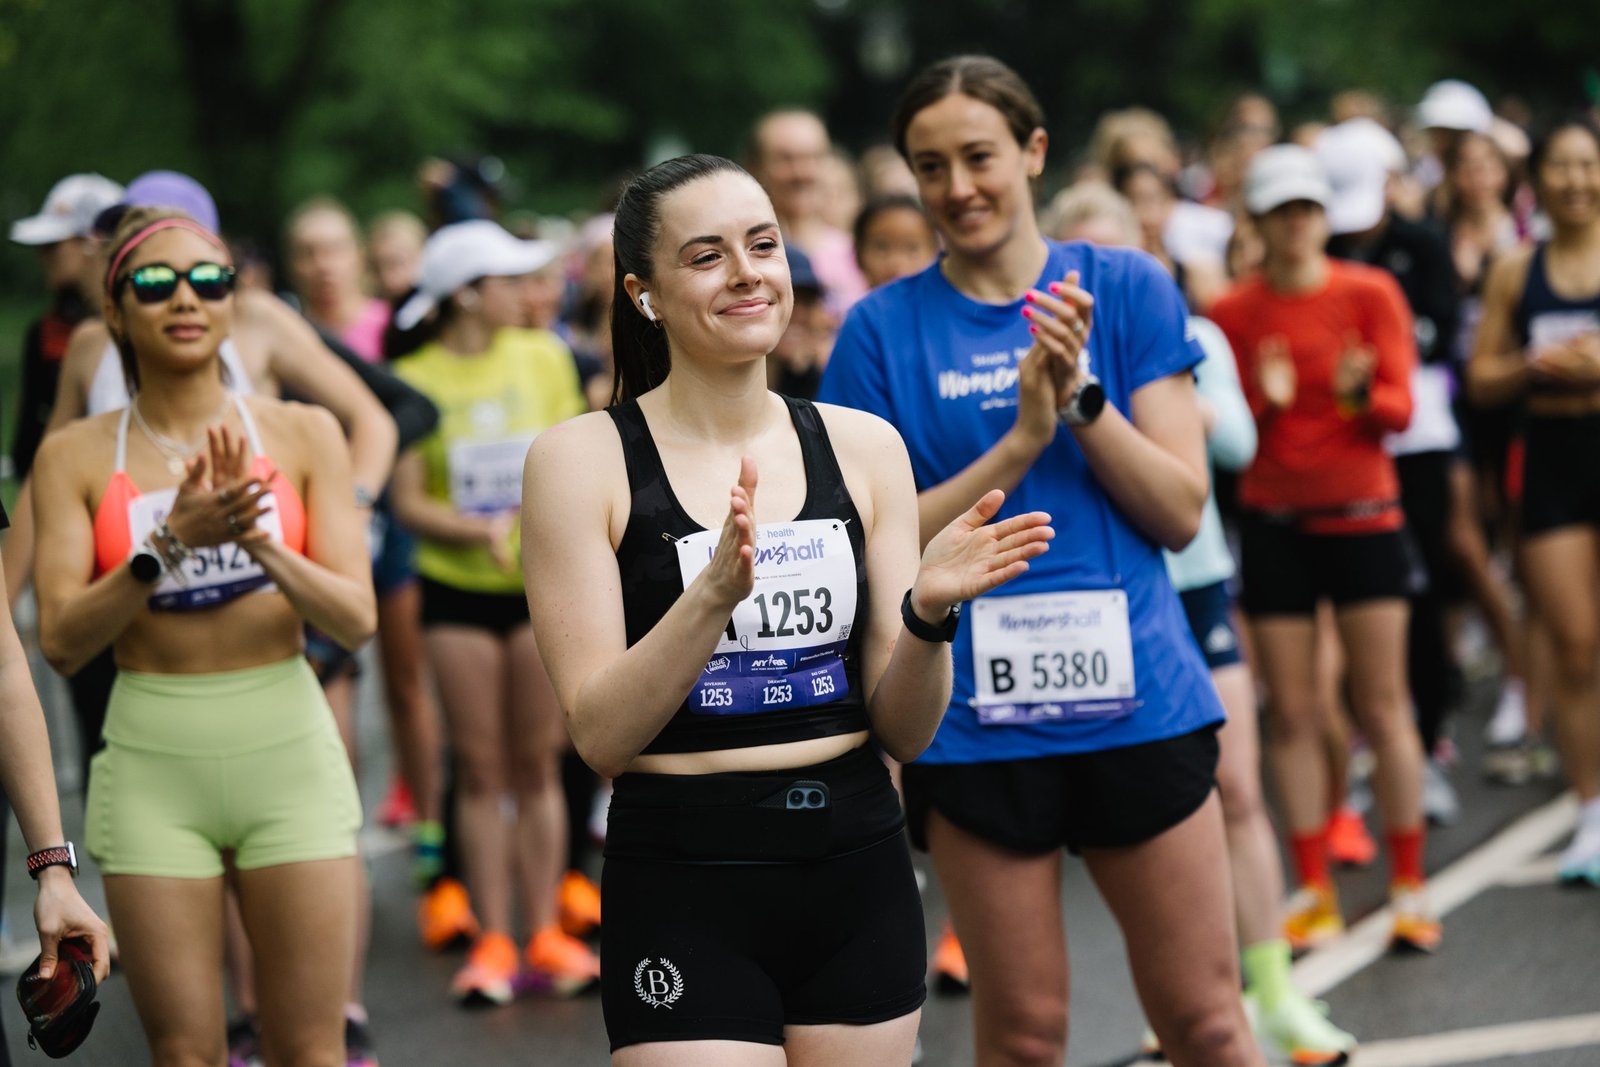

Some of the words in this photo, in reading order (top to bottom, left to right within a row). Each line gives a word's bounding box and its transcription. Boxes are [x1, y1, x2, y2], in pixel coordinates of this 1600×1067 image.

[766, 528, 795, 539] health
[753, 587, 833, 638] 1253
[708, 657, 725, 668] TRUE
[989, 657, 1016, 695] B
[1032, 649, 1109, 690] 5380
[762, 684, 793, 705] 1253
[811, 675, 835, 696] 1253
[700, 688, 733, 707] 1253
[647, 969, 670, 995] B
